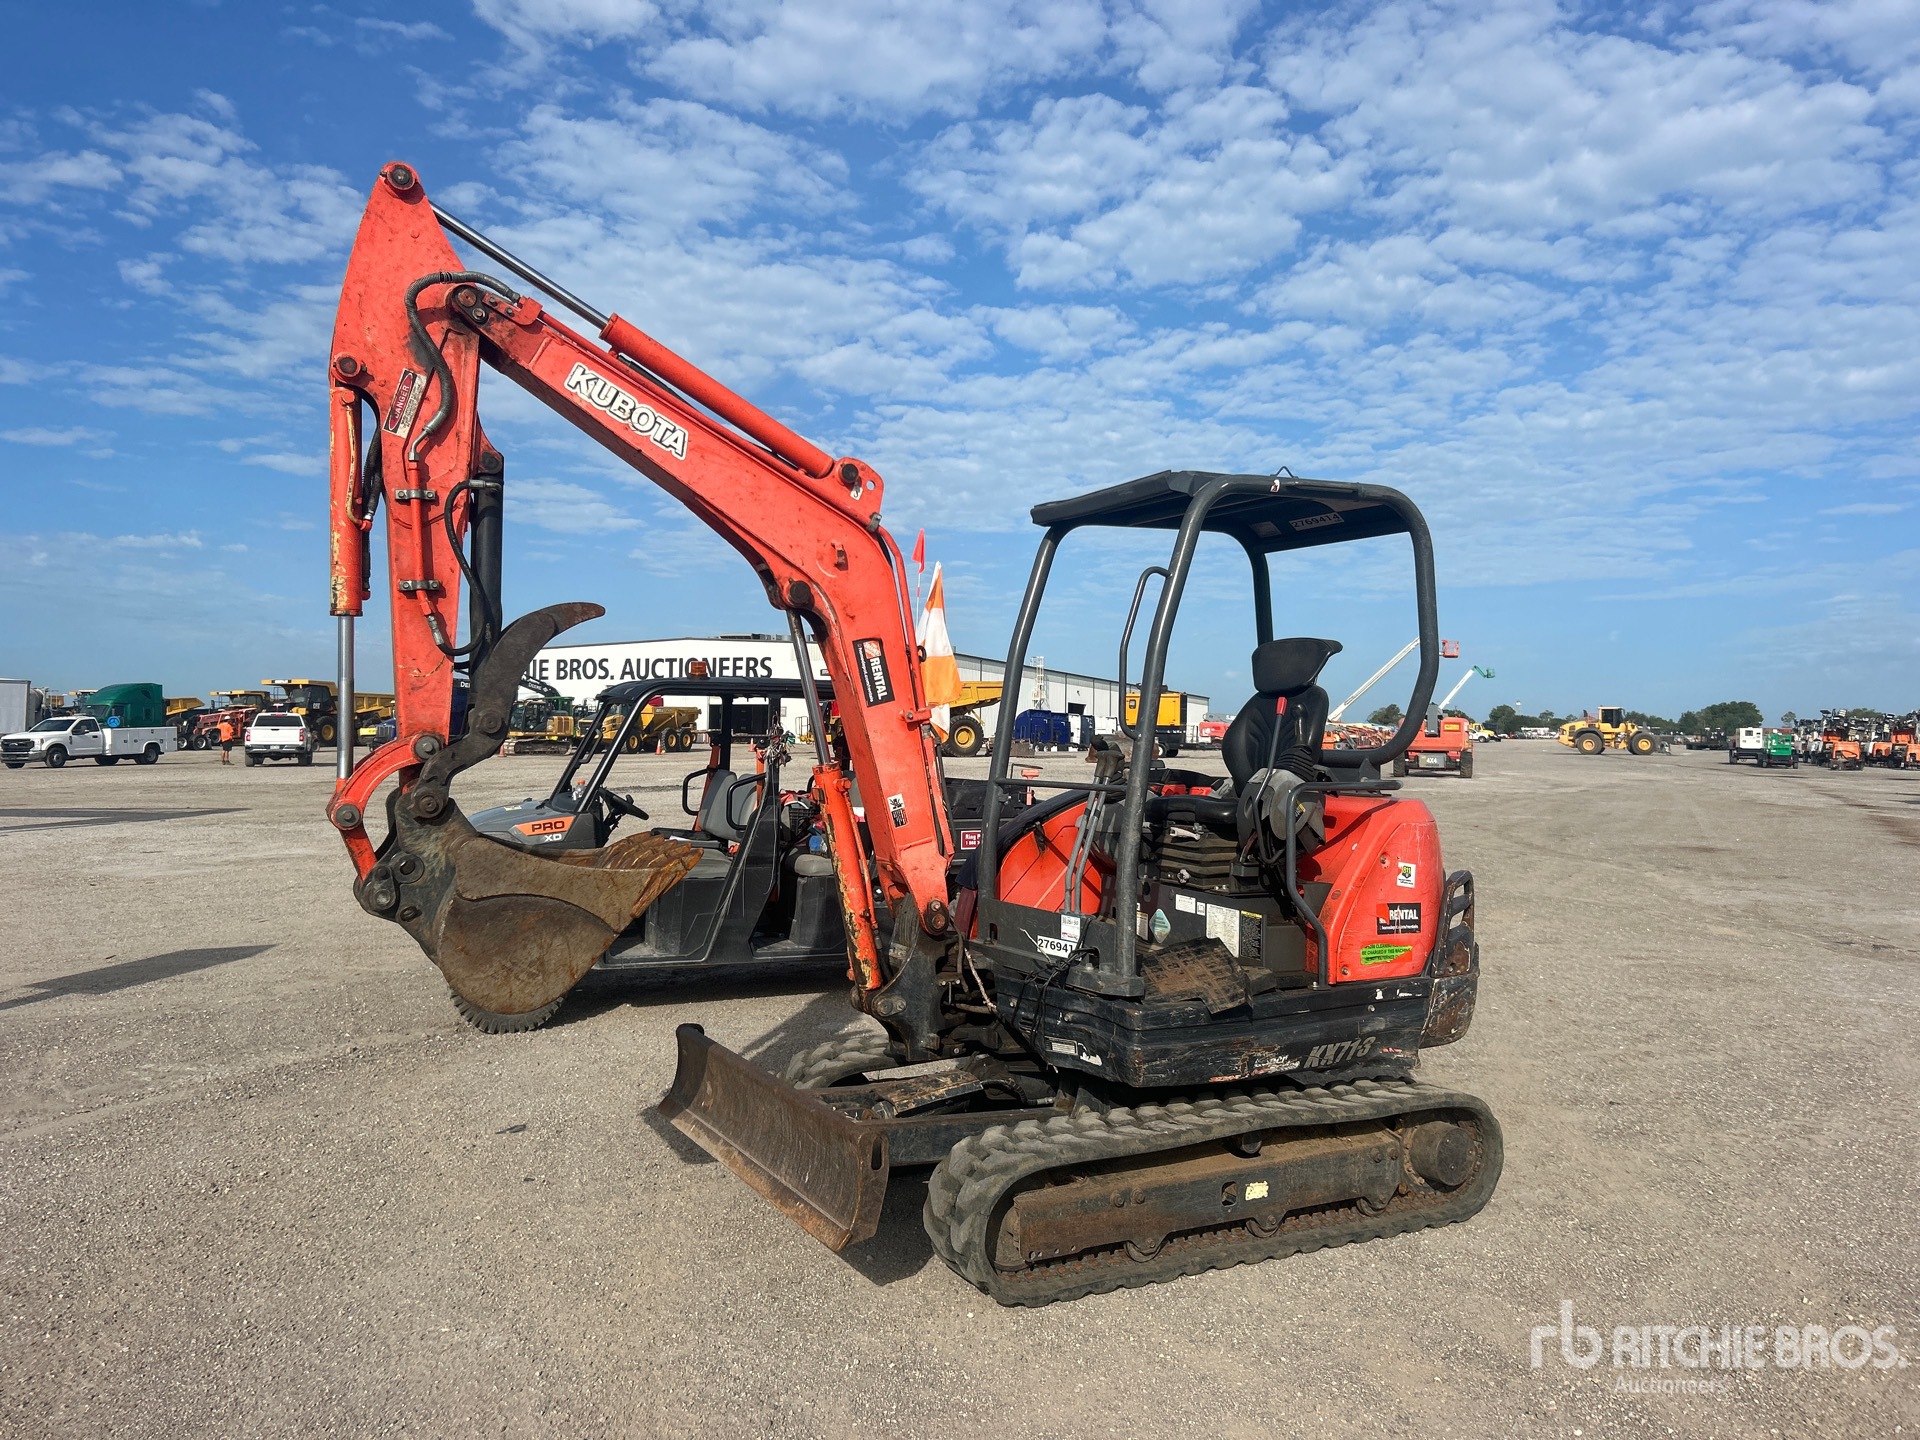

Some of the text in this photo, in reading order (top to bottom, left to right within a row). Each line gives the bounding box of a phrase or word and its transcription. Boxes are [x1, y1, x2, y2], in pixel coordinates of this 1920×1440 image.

[565, 363, 687, 459] KUBOTA
[1291, 513, 1340, 528] 2769414
[556, 658, 615, 680] BROS.
[869, 657, 888, 700] RENTAL
[531, 820, 565, 832] PRO
[544, 833, 562, 842] XD
[1389, 909, 1419, 920] RENTAL
